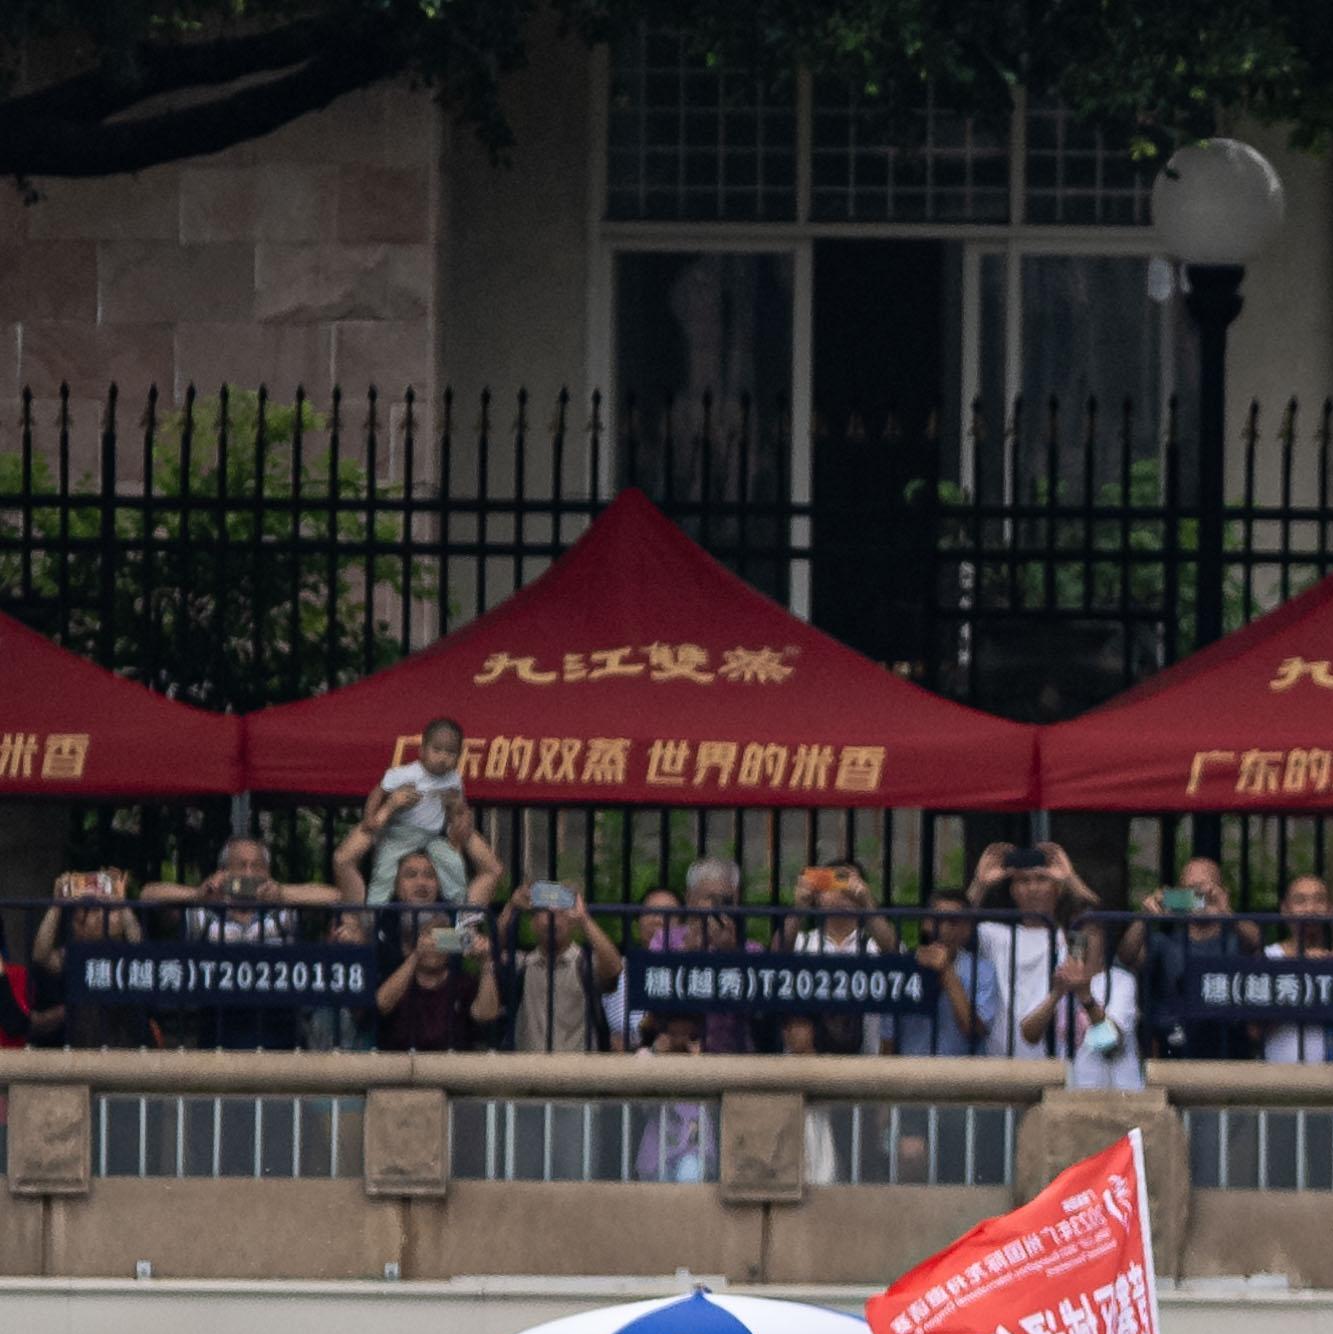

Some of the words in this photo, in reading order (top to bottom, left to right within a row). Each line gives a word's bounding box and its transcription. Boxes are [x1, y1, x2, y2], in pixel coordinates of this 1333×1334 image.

[0, 733, 90, 779] 米香
[645, 739, 887, 792] 世界的米香
[84, 958, 364, 993] 穗(越秀)T20220138
[644, 965, 923, 1001] 穗(越秀)T20220074
